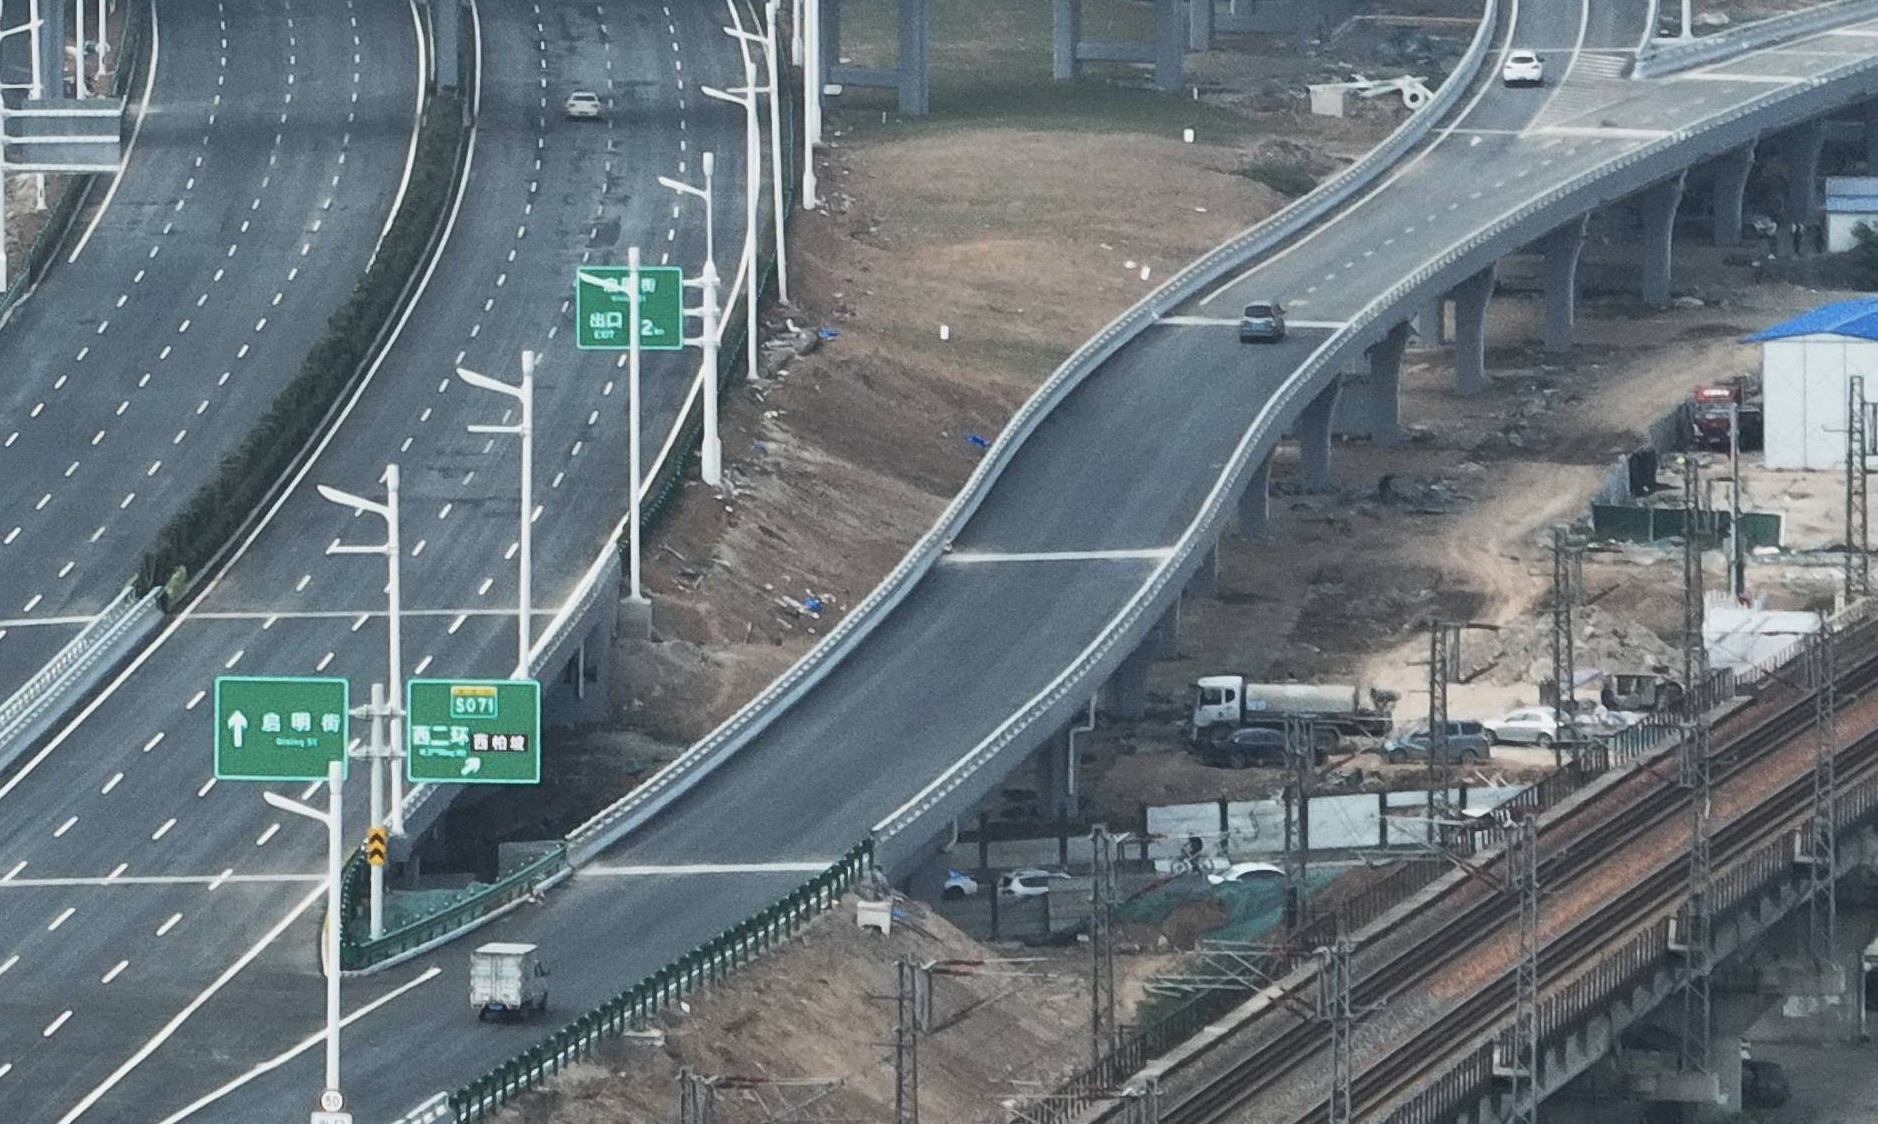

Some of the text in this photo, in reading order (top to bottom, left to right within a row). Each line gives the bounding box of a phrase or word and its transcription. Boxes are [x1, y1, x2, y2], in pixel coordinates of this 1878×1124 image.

[590, 311, 622, 329] 出口
[455, 697, 494, 713] S071
[412, 725, 469, 746] 西二环
[473, 733, 525, 751] 西柏坡
